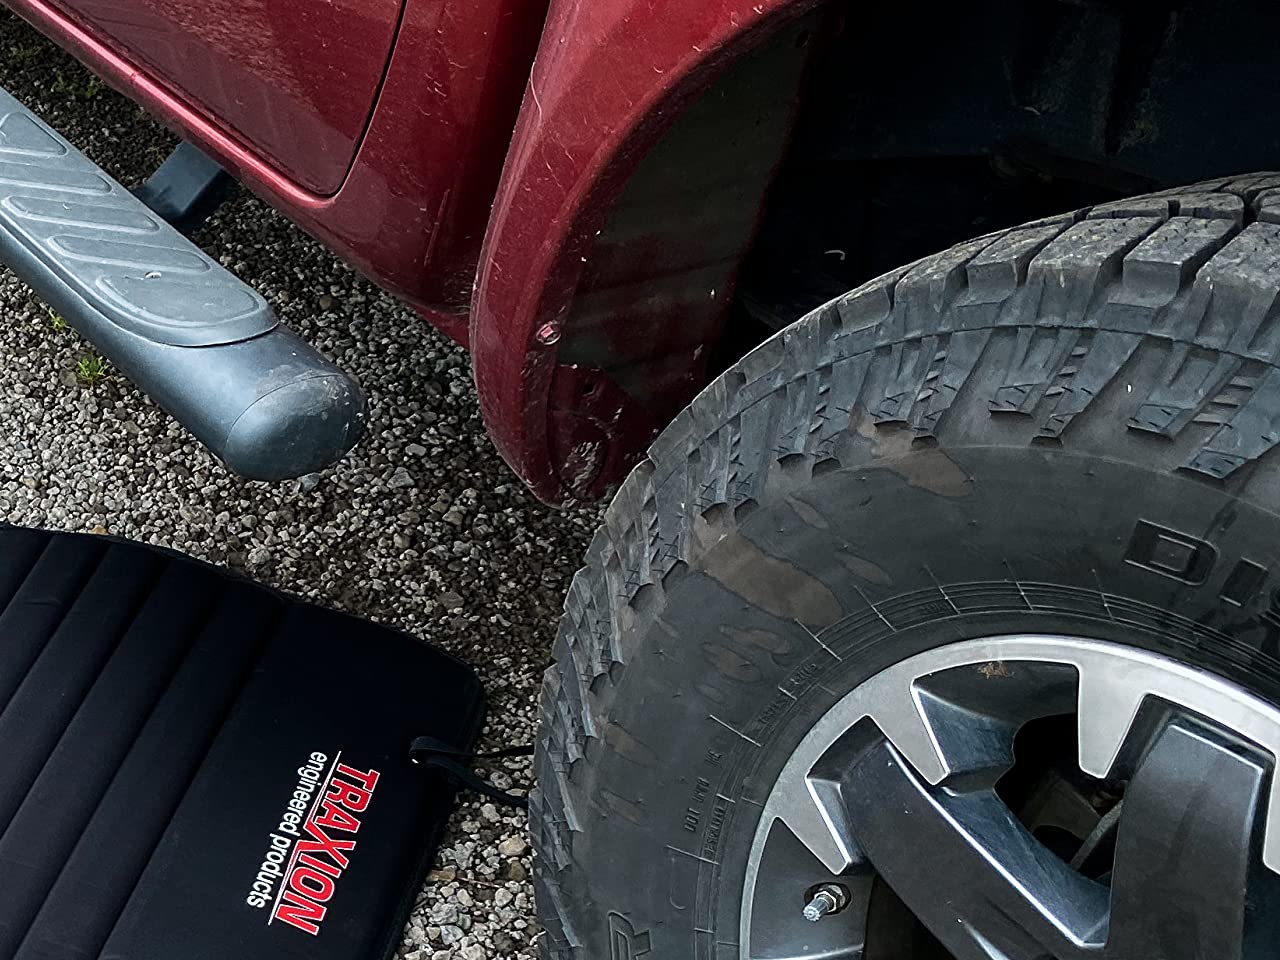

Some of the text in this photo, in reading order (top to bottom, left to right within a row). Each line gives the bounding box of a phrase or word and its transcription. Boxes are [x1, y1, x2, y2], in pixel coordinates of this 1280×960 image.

[1124, 518, 1280, 626] DI
[246, 751, 327, 908] engineered products
[274, 762, 380, 936] TRAXION
